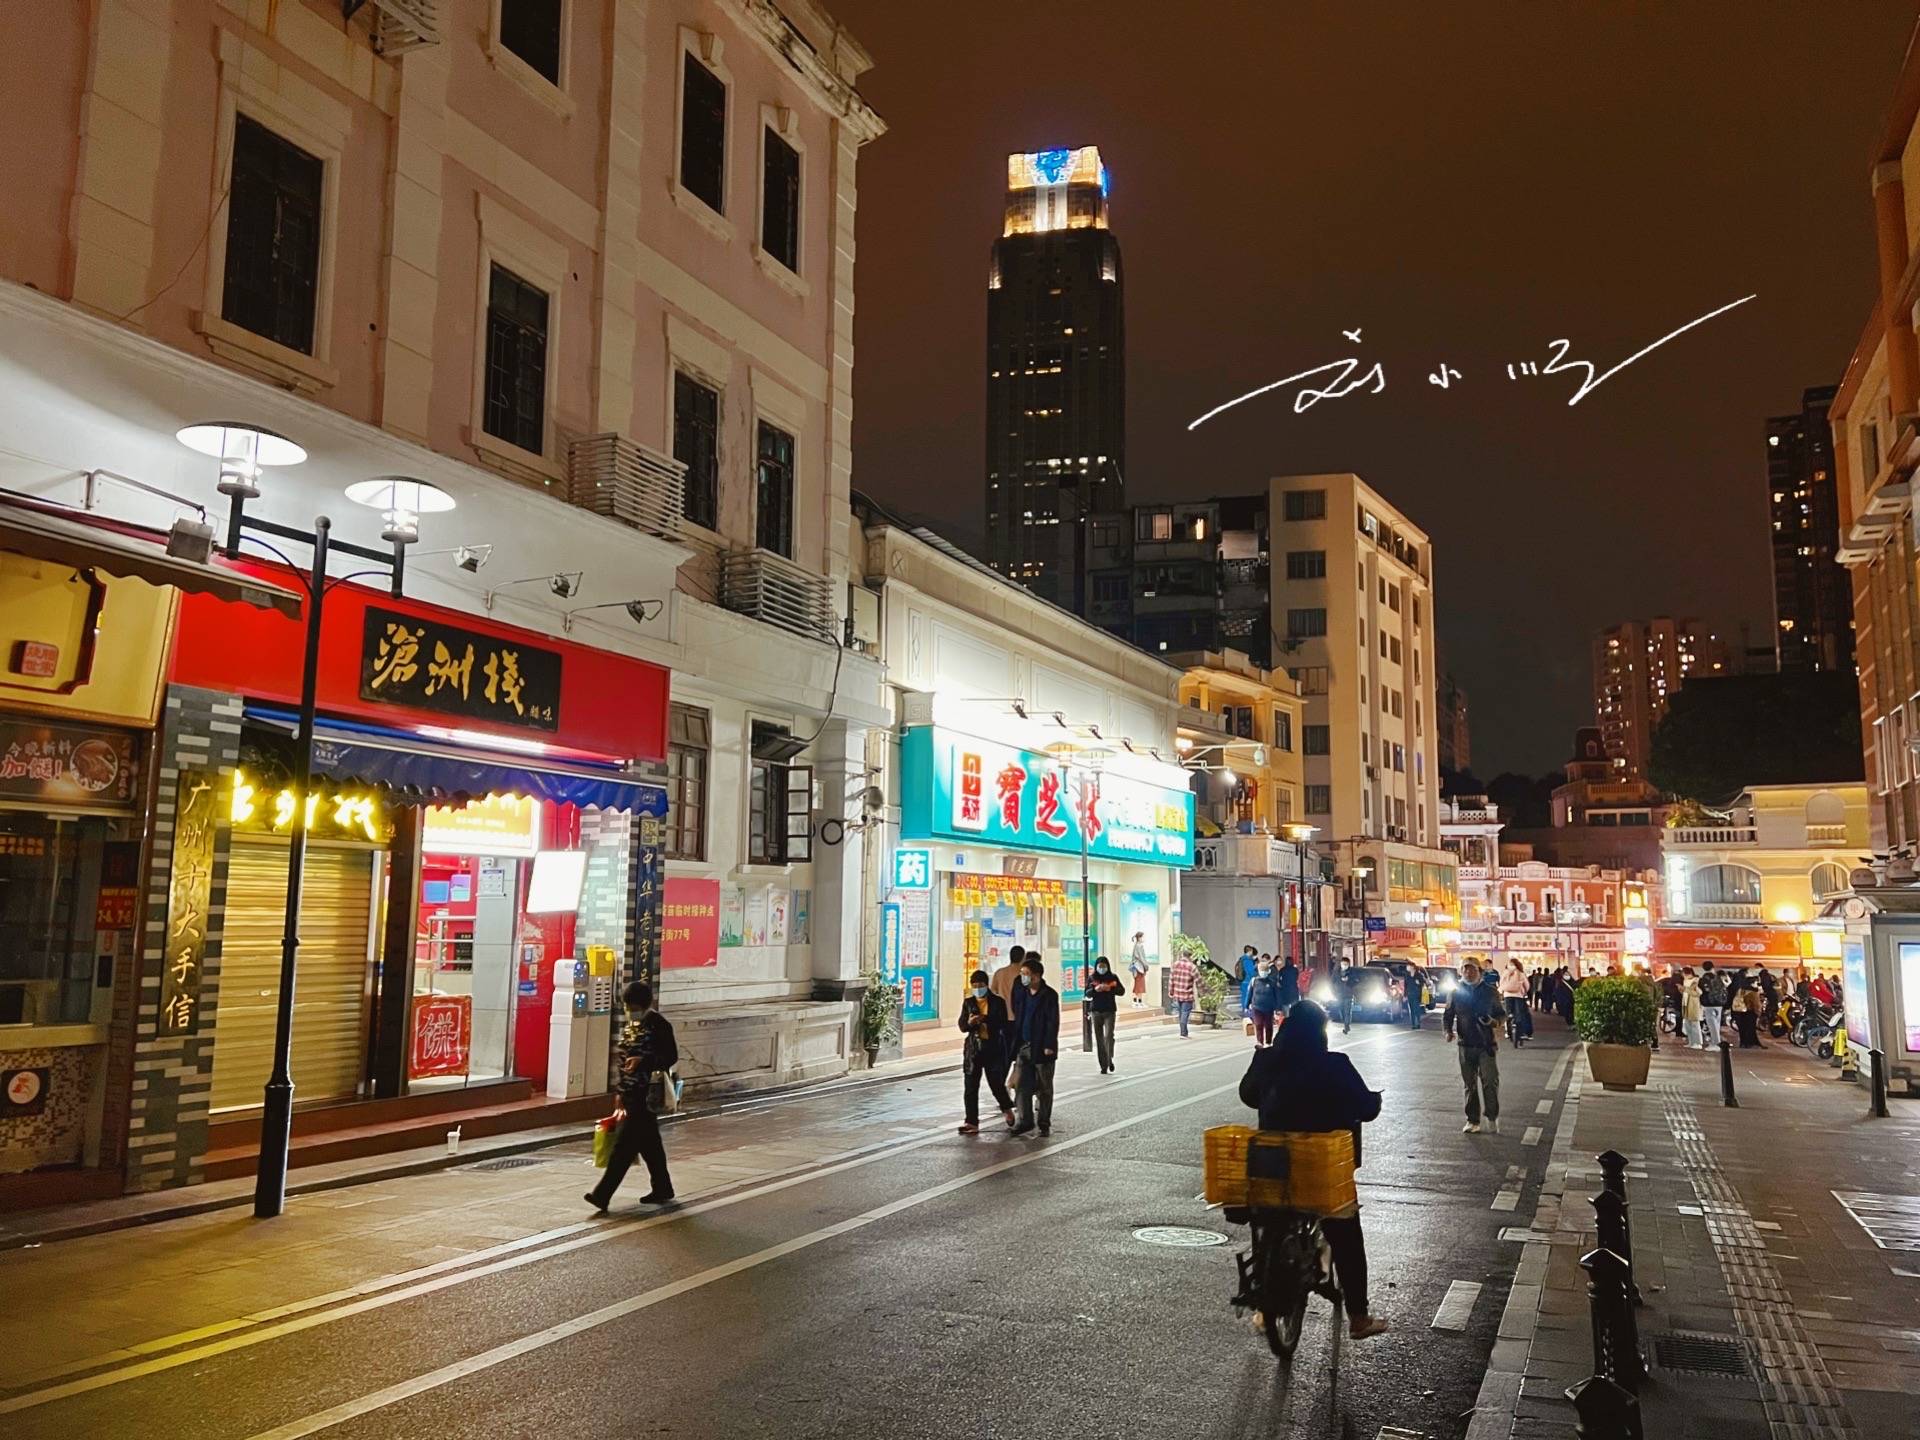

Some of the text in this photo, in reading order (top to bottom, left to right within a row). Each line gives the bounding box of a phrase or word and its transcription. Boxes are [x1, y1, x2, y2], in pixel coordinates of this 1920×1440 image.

[166, 779, 211, 1028] 广州十大手信
[898, 853, 926, 885] 药
